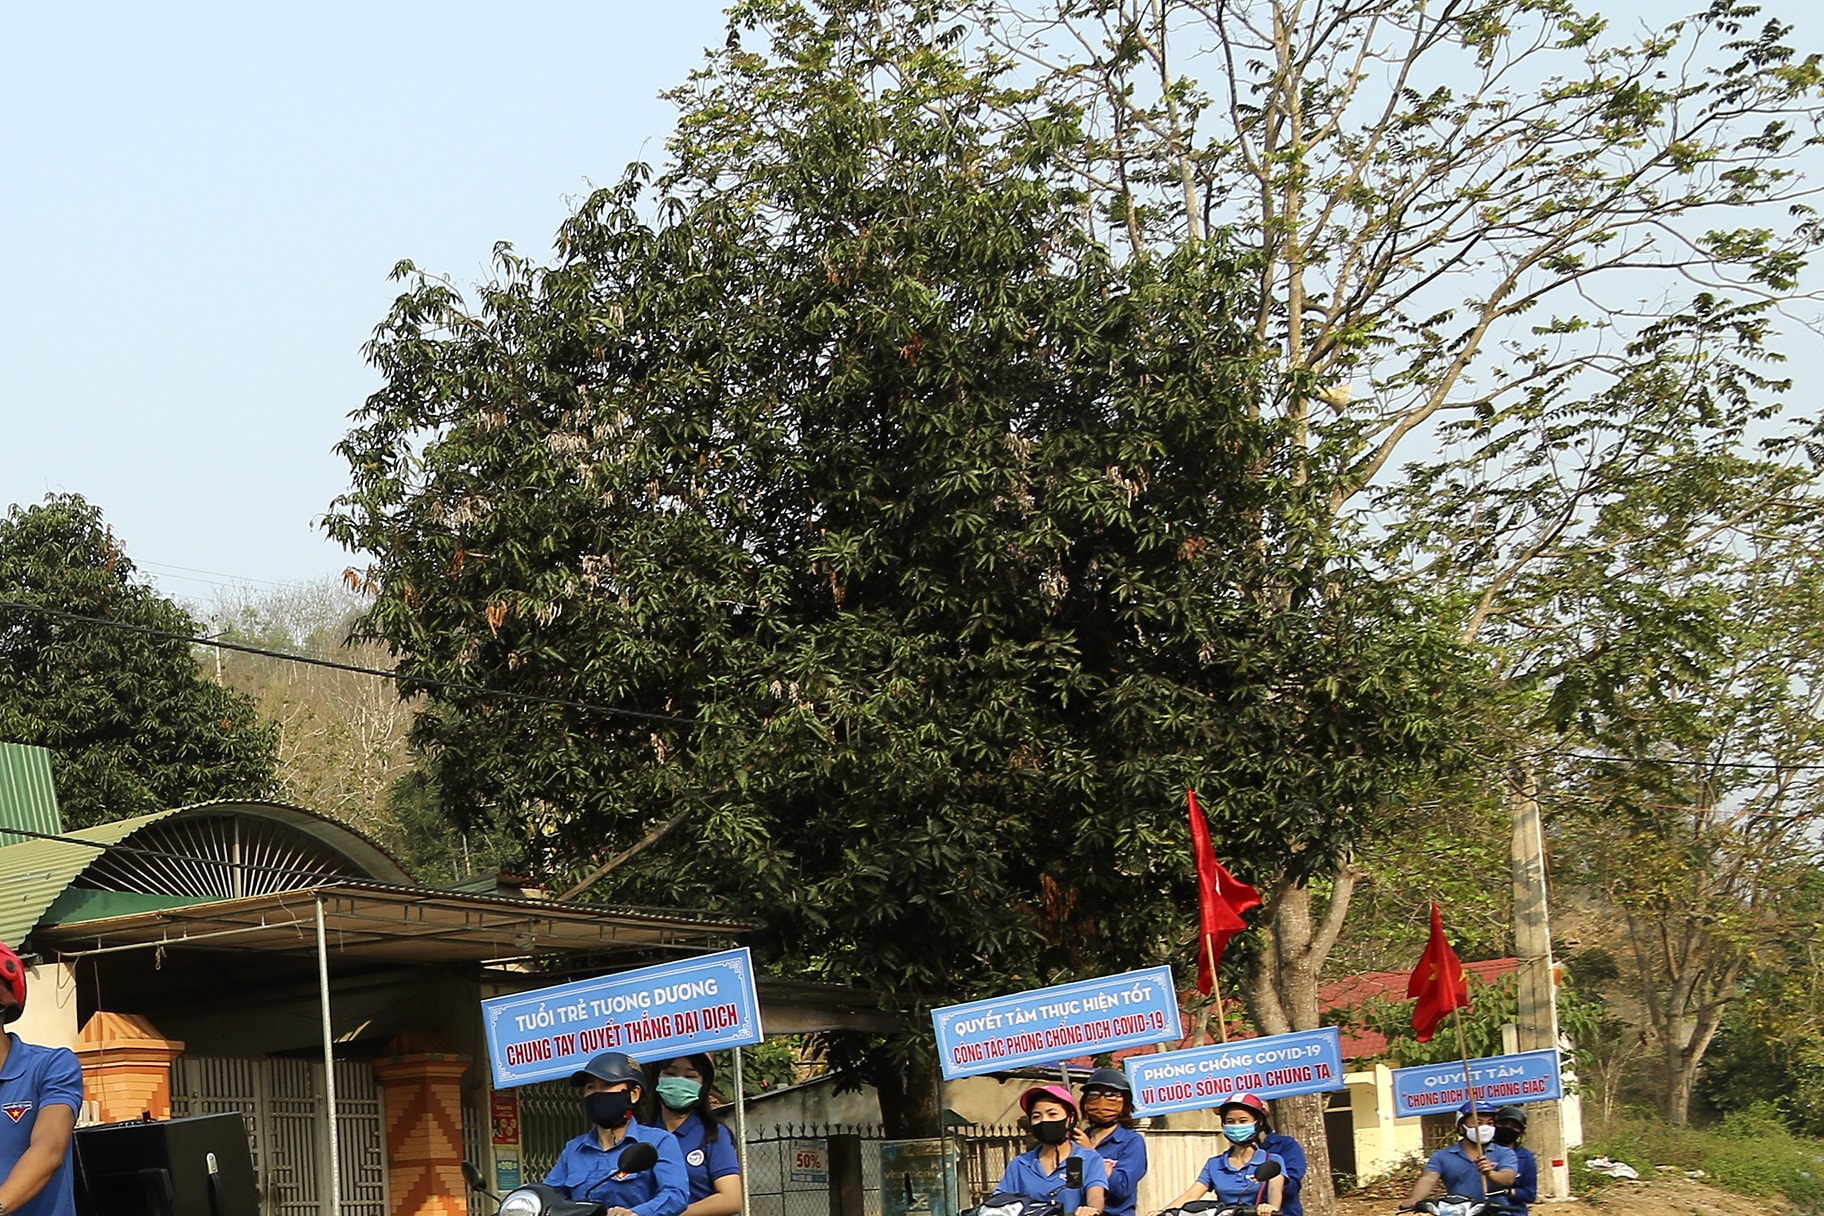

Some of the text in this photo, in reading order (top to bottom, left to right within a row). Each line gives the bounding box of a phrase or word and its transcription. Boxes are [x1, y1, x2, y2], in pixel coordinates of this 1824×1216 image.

[515, 978, 718, 1032] TUỔI TRẺ TƯƠNG DƯƠNG
[955, 983, 1152, 1037] QUYẾT TÂM THỰC HIỆN TỐT
[506, 1002, 738, 1066] CHUNG TAY QUYẾT THẮNG ĐẠI DỊCH
[953, 1010, 1164, 1065] CÔNG TÁC PHÒNG CHỐNG DỊCH COVID-19
[1141, 1062, 1332, 1105] VÌ CUỘC SỐNG CỦA CHÚNG TA
[1144, 1044, 1321, 1081] PHÒNG CHỐNG COVID-19
[1424, 1064, 1524, 1087] QUYẾT TÂM
[1440, 1089, 1463, 1106] DỊCH
[1487, 1078, 1520, 1098] CHỐNG
[796, 1153, 822, 1169] 50%
